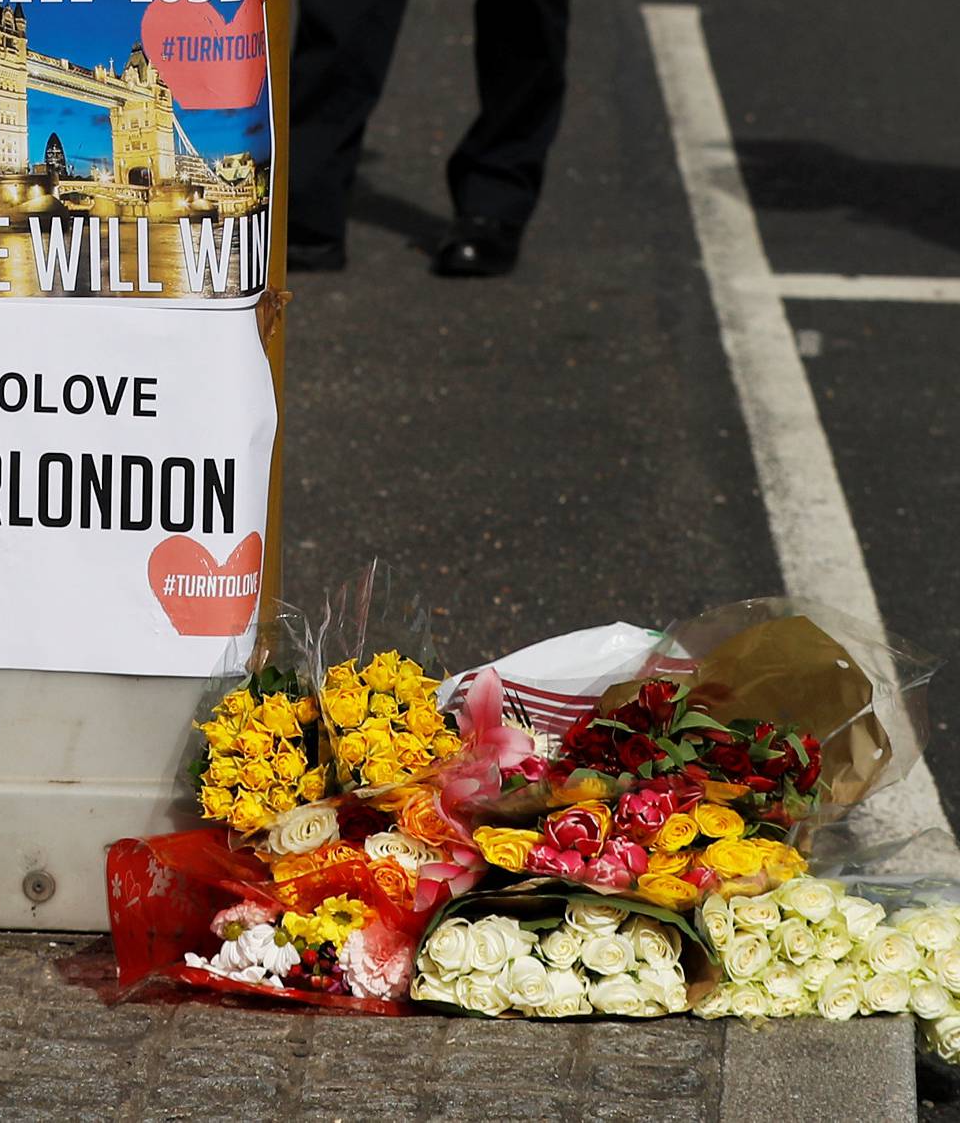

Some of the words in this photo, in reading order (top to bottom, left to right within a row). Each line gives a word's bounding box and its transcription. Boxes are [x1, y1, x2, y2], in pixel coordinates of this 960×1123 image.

[29, 216, 163, 292] WILL
[180, 210, 266, 293] WIN
[163, 571, 258, 598] #TURNTOLOVE
